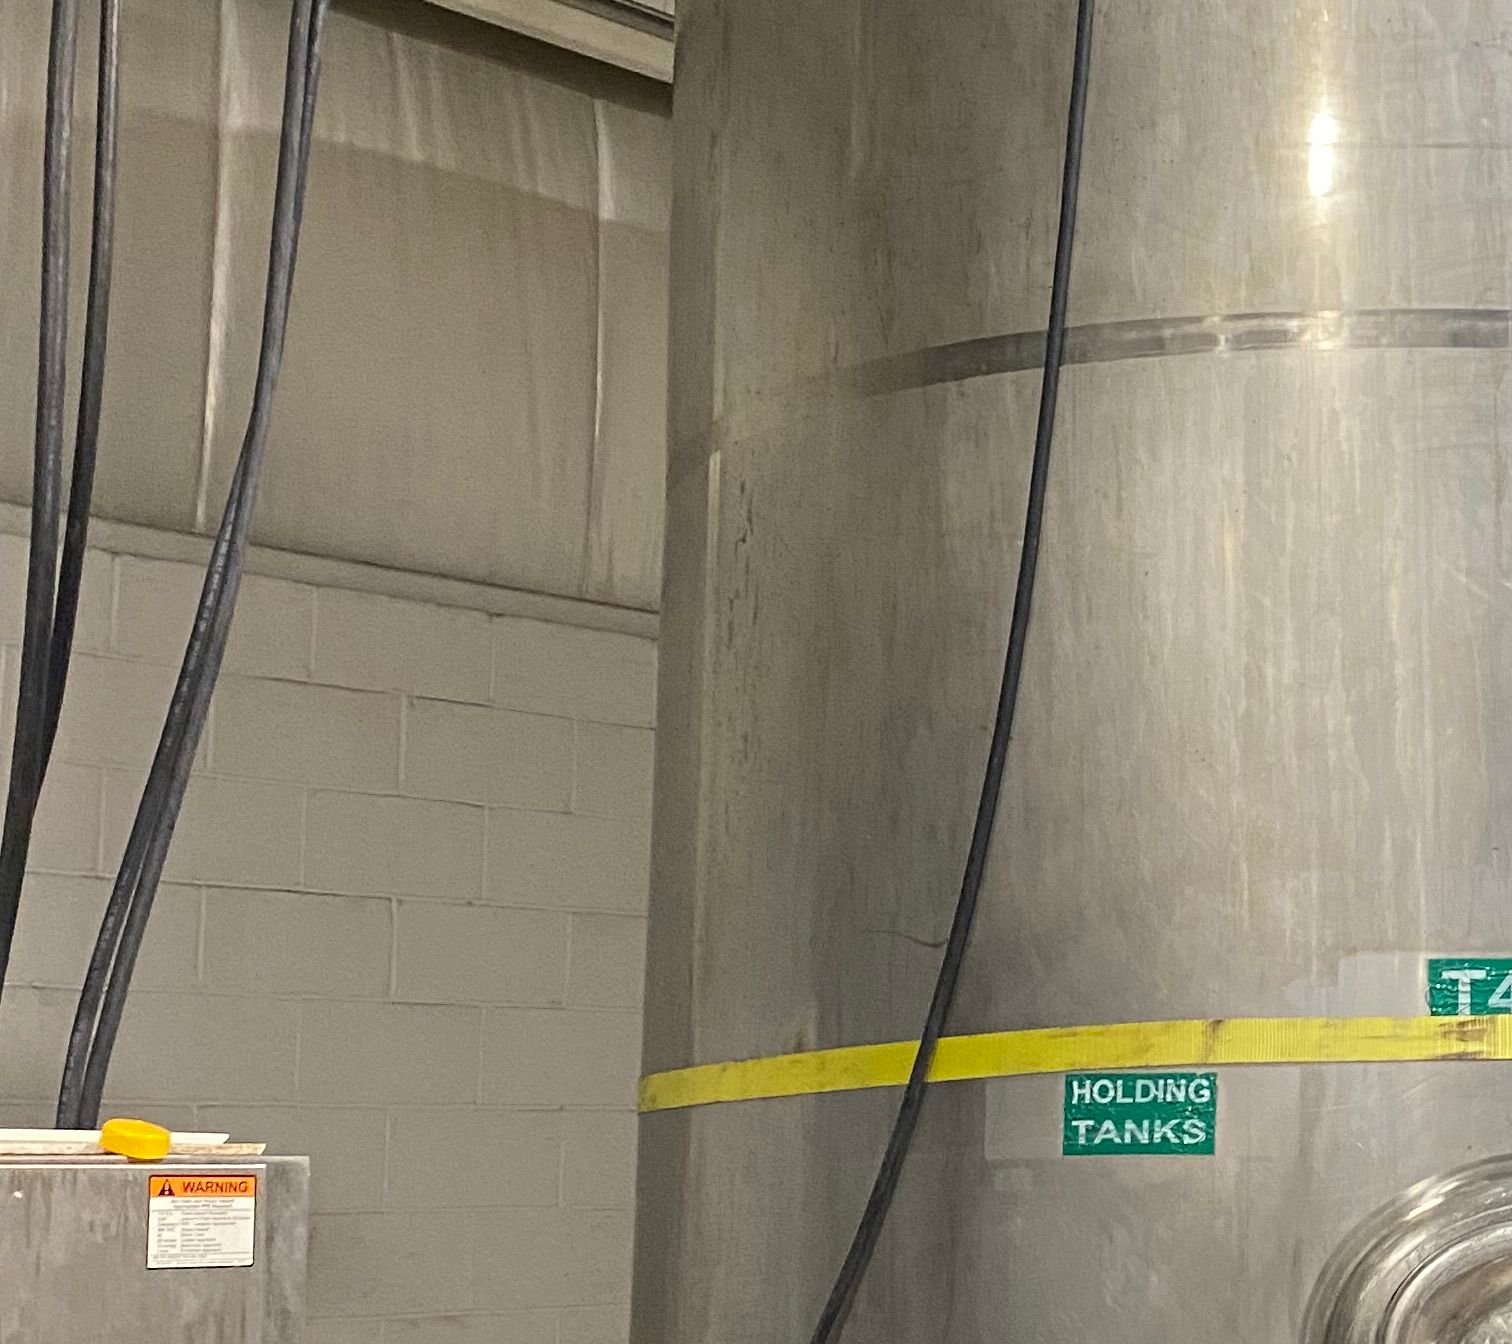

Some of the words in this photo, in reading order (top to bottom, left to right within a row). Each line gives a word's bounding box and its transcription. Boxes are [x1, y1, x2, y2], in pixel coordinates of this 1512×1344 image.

[1072, 1078, 1211, 1105] HOLDING
[1071, 1119, 1207, 1145] TANKS
[182, 1180, 248, 1193] WARNING
